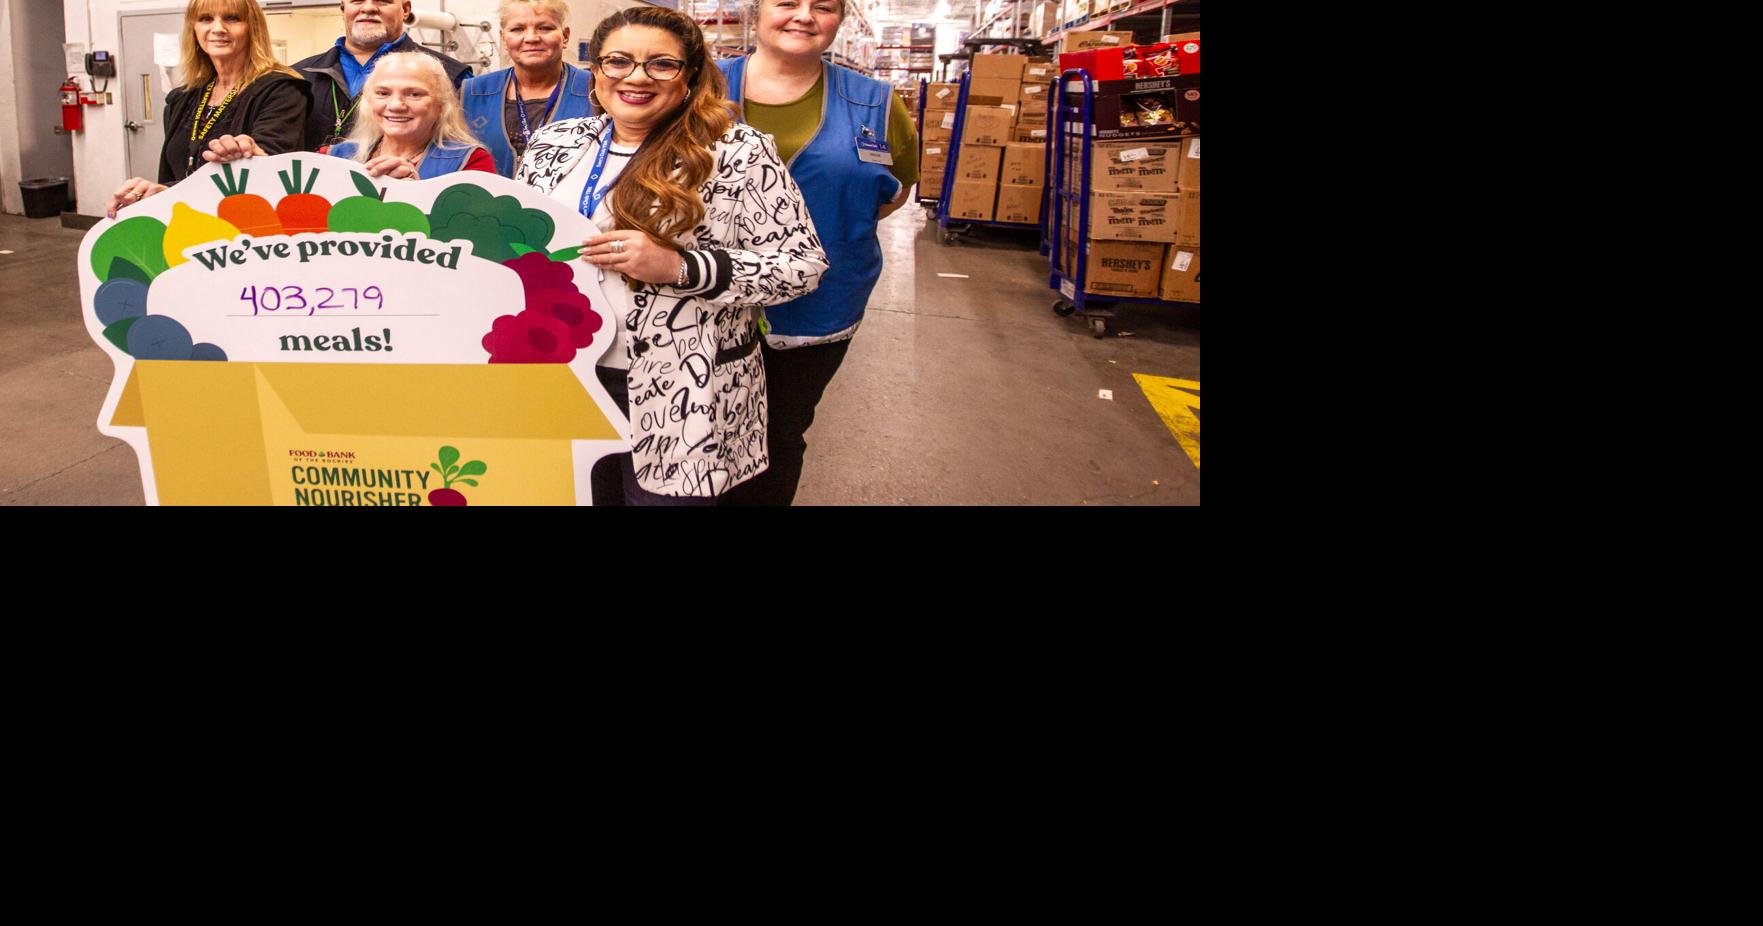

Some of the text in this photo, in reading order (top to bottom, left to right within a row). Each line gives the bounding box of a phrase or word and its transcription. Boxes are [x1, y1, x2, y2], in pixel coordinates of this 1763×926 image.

[1136, 80, 1171, 90] HERSHEY'S
[198, 117, 216, 140] SAFETY
[192, 235, 462, 271] We've provided
[1101, 257, 1152, 271] HERSHEY'S
[240, 285, 383, 316] 403,279
[279, 327, 393, 352] meals!
[289, 449, 356, 459] FOOD BANK
[292, 466, 430, 490] COMMUNITY
[295, 488, 421, 506] NOURISHER
